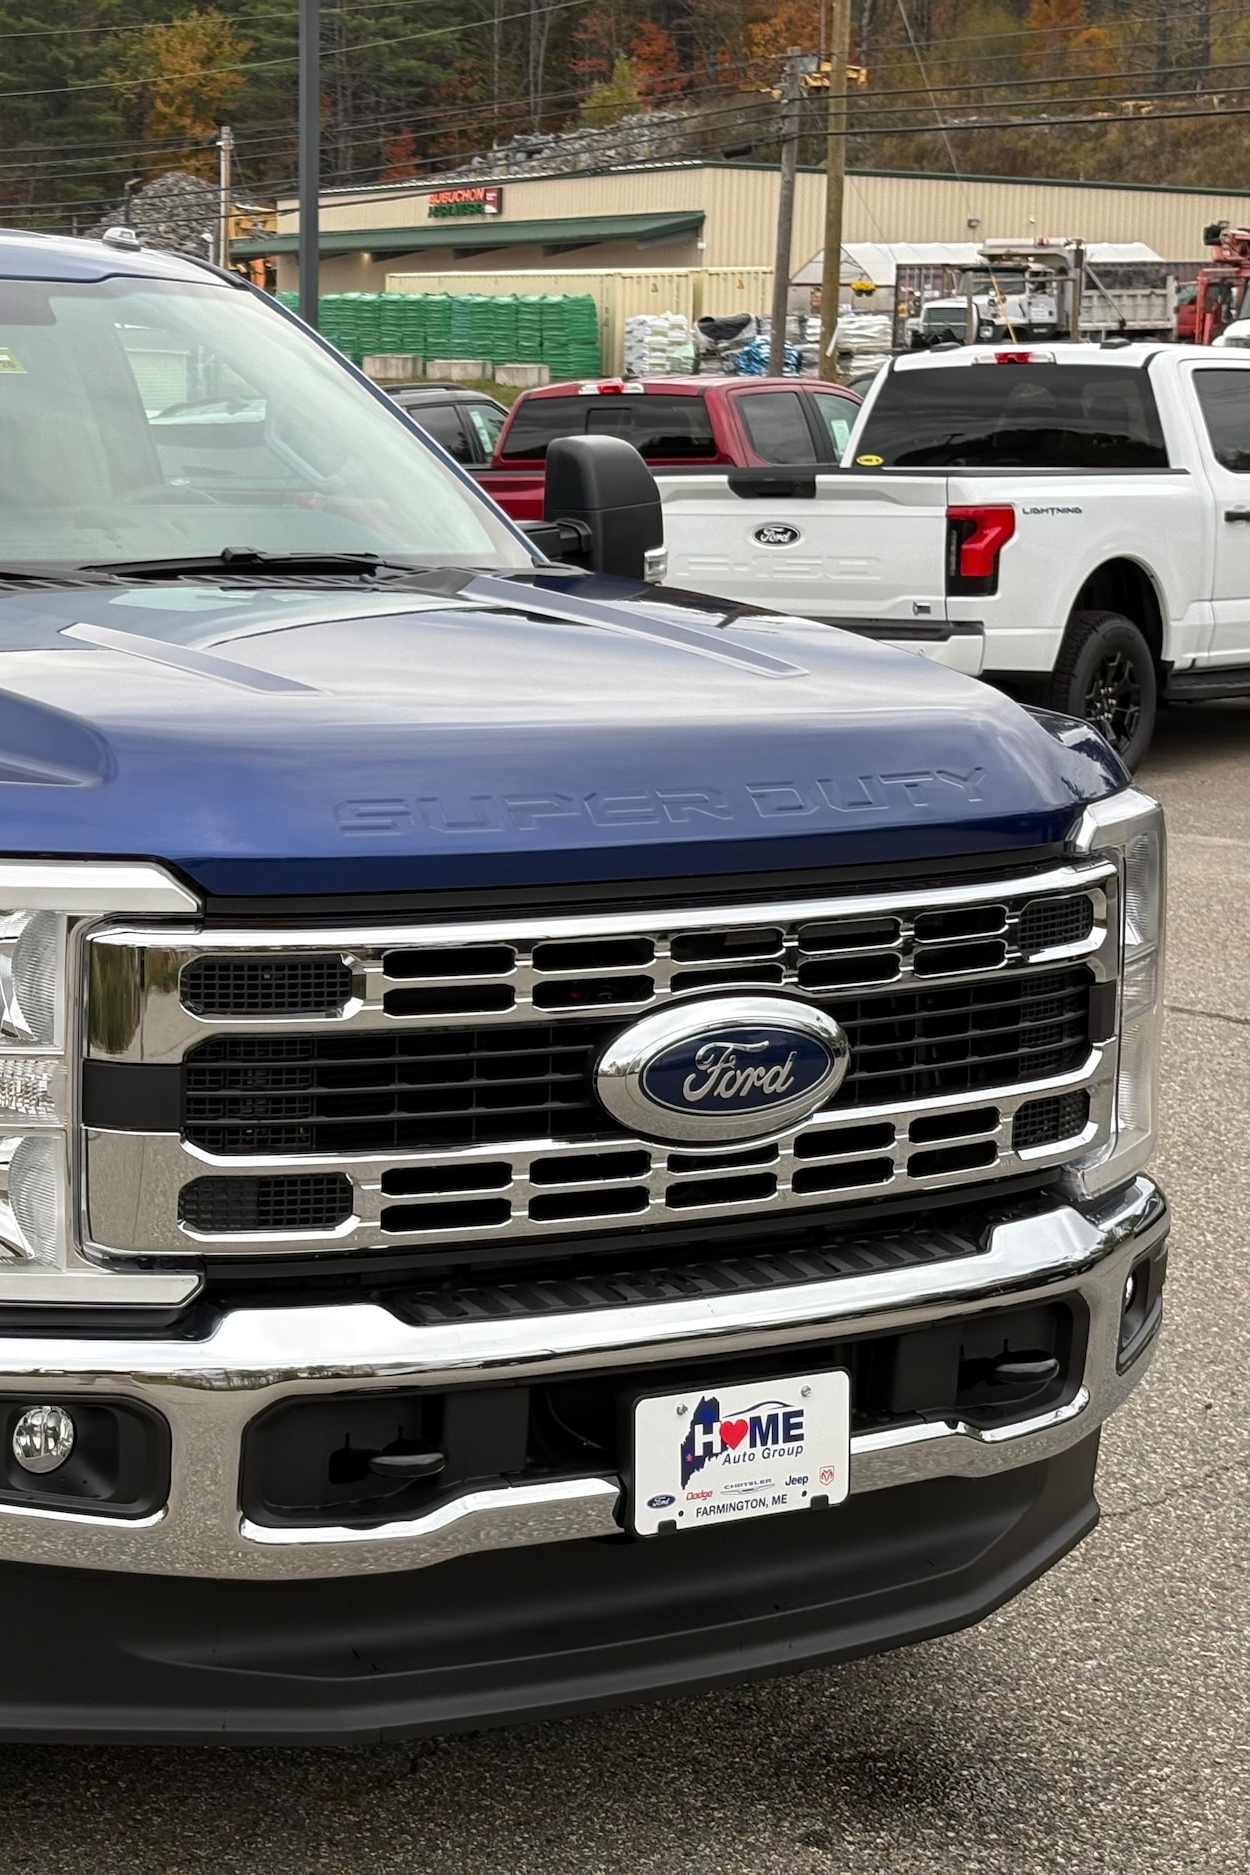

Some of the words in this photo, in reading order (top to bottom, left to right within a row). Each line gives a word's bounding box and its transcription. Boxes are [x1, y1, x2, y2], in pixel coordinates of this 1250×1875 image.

[1022, 506, 1083, 516] LIGHTNING
[760, 528, 792, 543] Ford
[332, 787, 735, 836] SUPER
[745, 766, 988, 818] DUTY
[683, 1040, 797, 1101] Ford
[721, 1451, 755, 1466] Auto
[762, 1444, 804, 1460] Group
[686, 1490, 713, 1501] Dodge
[723, 1478, 772, 1490] CHRYSLER
[785, 1475, 808, 1487] Jeep
[696, 1497, 769, 1518] FARMINGTON,
[772, 1494, 788, 1506] ME
